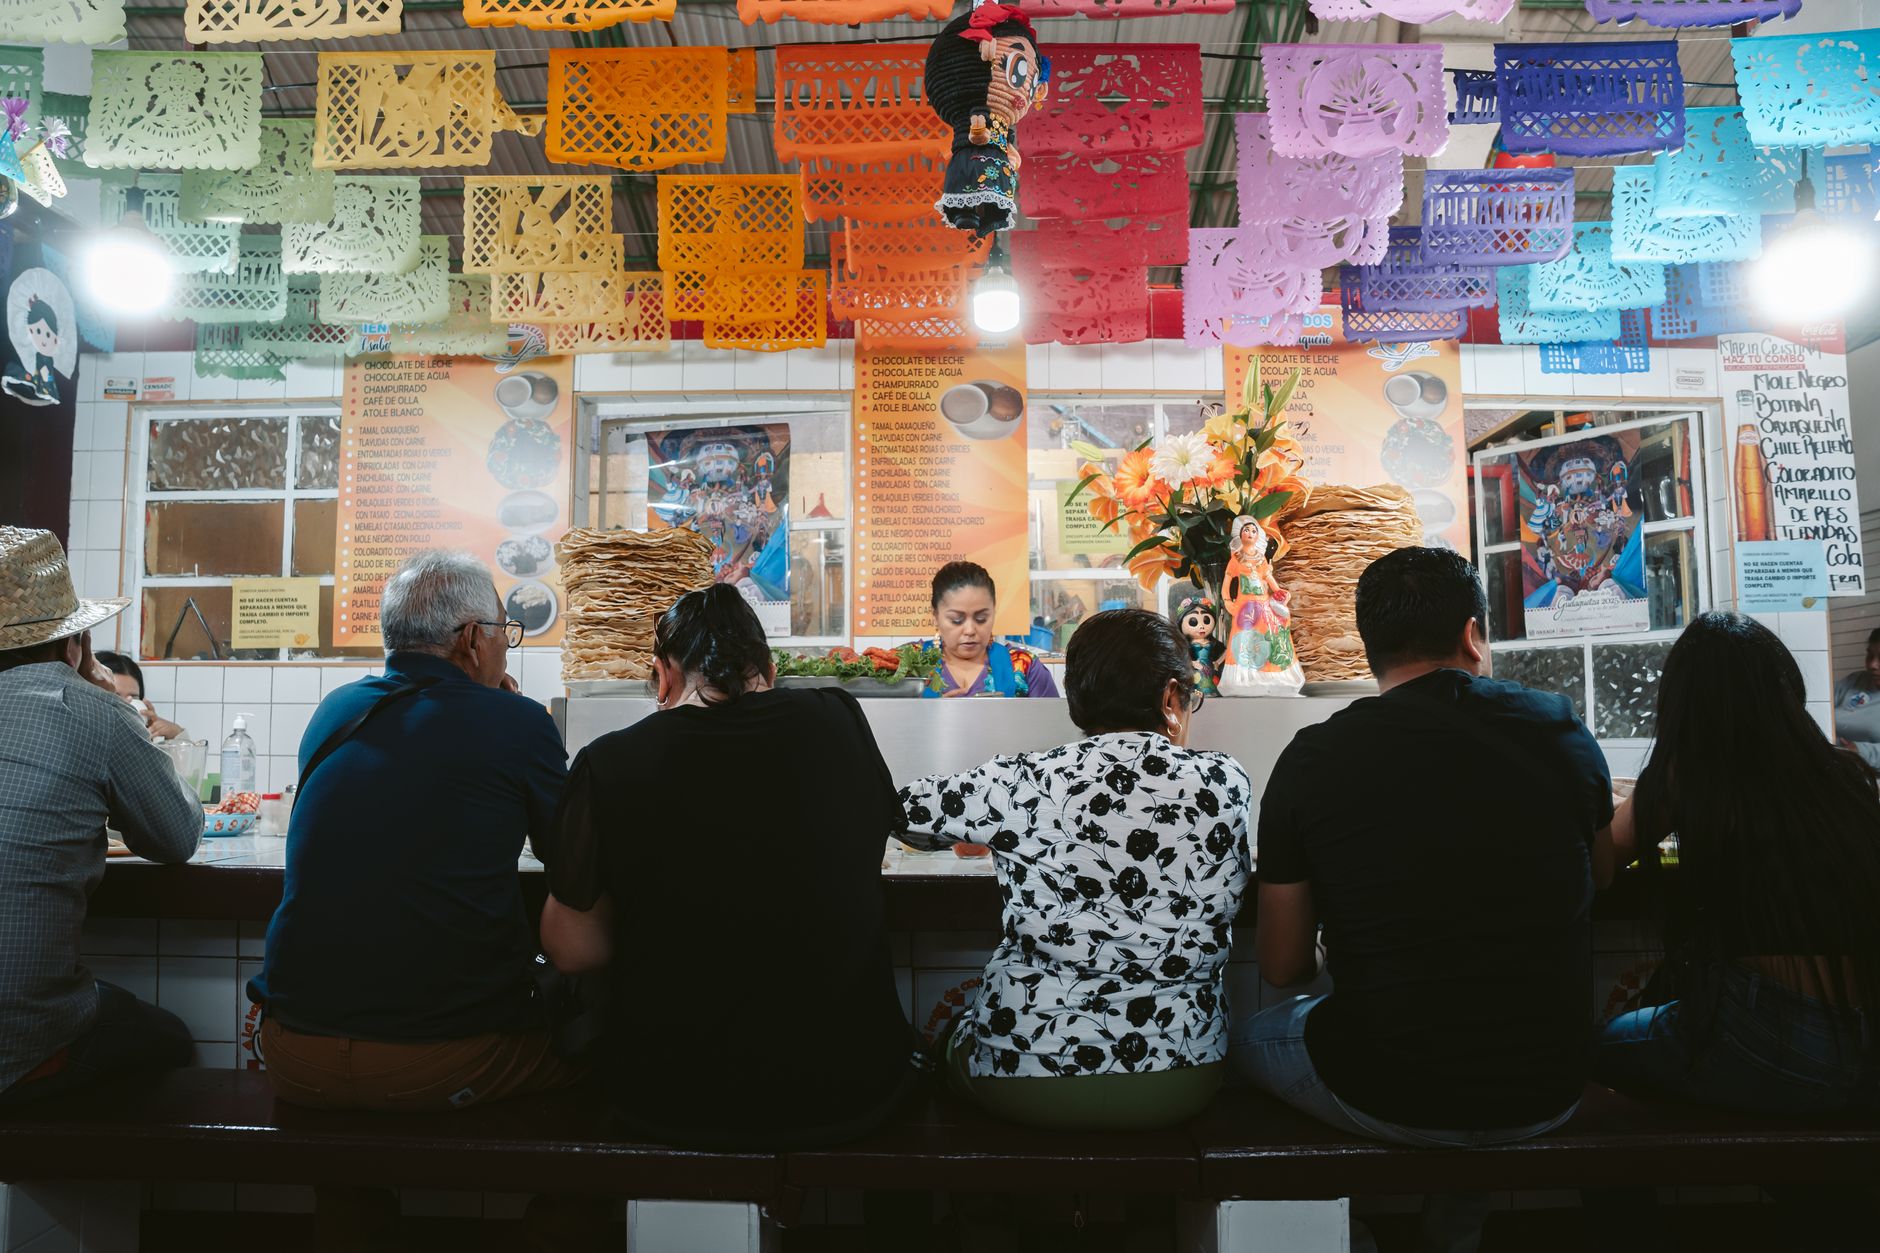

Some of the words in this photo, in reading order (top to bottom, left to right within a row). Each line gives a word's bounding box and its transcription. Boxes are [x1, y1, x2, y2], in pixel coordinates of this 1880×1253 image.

[872, 357, 922, 365] CHOCOLATE
[1300, 355, 1311, 363] DE
[1313, 355, 1339, 363] LECHE
[1766, 355, 1804, 363] COMBO
[365, 361, 412, 370] CHOCOLATE
[414, 361, 426, 369] DE
[428, 360, 452, 369] LECHE
[364, 373, 412, 381] CHOCOLATE
[414, 372, 425, 381] DE
[427, 372, 450, 380] AGUA
[873, 381, 938, 389] CHAMPURRADO
[364, 385, 427, 394] CHAMPURRADO
[873, 391, 894, 400] CAFÉ
[896, 392, 907, 400] DE
[909, 392, 931, 400] OLLA
[363, 396, 383, 405] CAFÉ
[386, 397, 396, 405] DE
[398, 397, 418, 405] OLLA
[873, 404, 899, 412] ATOLE
[902, 404, 936, 412] BLANCO
[363, 409, 389, 417] ATOLE
[392, 408, 423, 416] BLANCO
[381, 426, 419, 434] OAXAQUEÑO
[895, 422, 935, 430] OAXAQUEÑO
[872, 434, 904, 442] TLAYUDAS
[905, 434, 920, 442] CON
[1775, 485, 1851, 505] AMARILLO
[1789, 507, 1809, 522] DE
[355, 535, 371, 543] MOLE
[373, 535, 393, 543] NEGRO
[354, 548, 392, 556] COLORADITO
[394, 548, 407, 556] CON
[1826, 544, 1861, 567] Cola
[872, 554, 893, 562] CALDO
[895, 554, 903, 562] DE
[905, 554, 916, 562] RES
[353, 560, 374, 568] CALDO
[376, 560, 383, 568] DE
[385, 560, 395, 568] RES
[375, 573, 383, 581] DE
[871, 594, 900, 602] PLATILLO
[352, 625, 368, 633] CHILE
